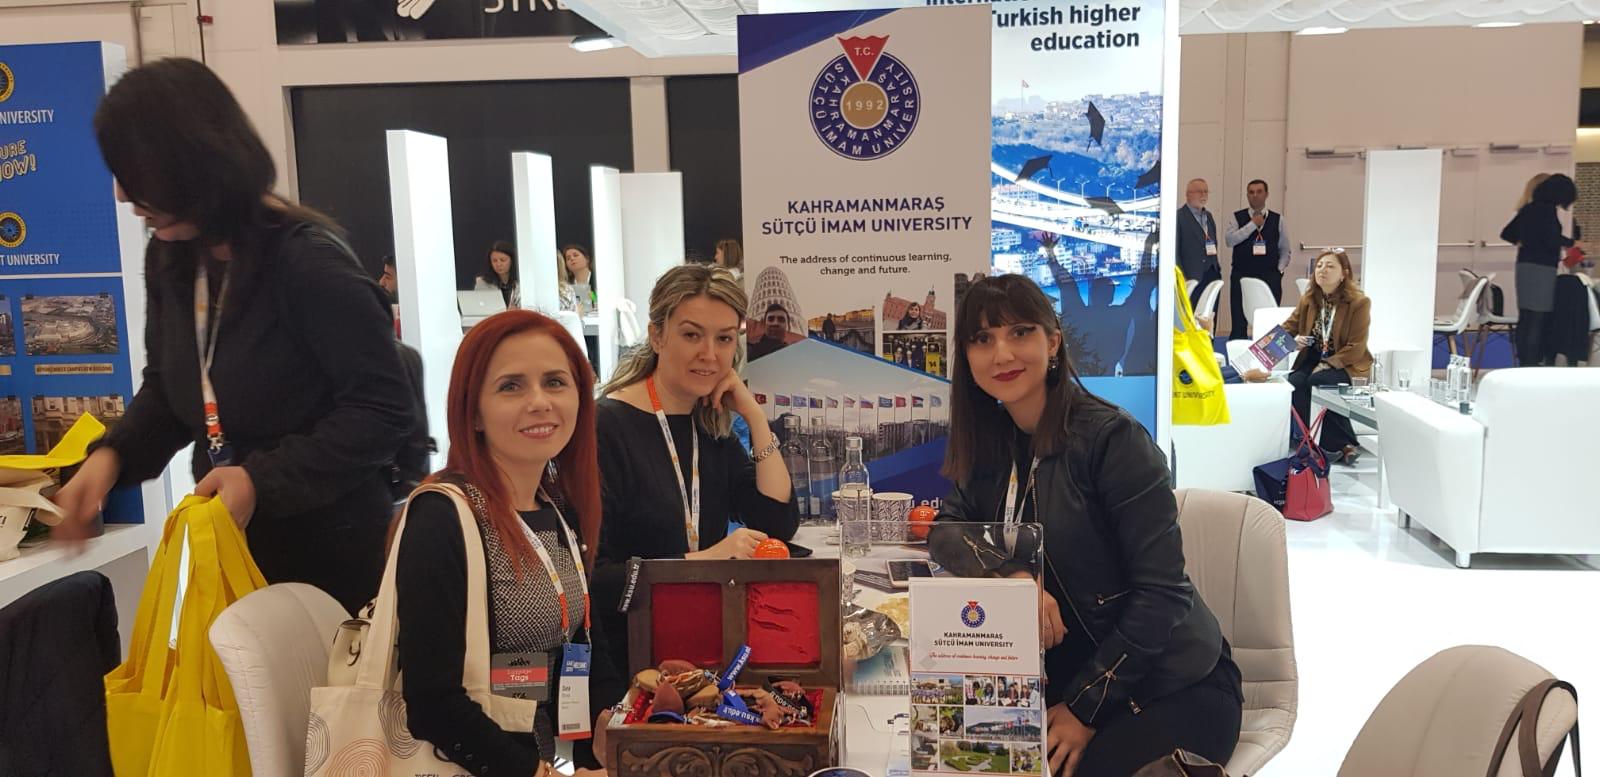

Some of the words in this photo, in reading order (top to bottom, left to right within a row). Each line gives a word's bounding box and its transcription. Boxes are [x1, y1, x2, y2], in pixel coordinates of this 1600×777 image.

[992, 7, 1063, 27] urkish
[1069, 4, 1141, 26] higher
[1030, 30, 1140, 51] education
[854, 47, 875, 56] T.C.
[846, 100, 884, 111] 1992
[871, 63, 914, 154] UNIVERSITY
[0, 153, 37, 182] OW!
[787, 197, 945, 214] KAHRAMANMARAŞ
[761, 217, 817, 236] SÜTÇÜ
[821, 217, 866, 234] İMAM
[871, 216, 973, 232] UNIVERSITY
[7, 253, 60, 266] UNIVERSITY
[779, 256, 798, 264] The
[800, 255, 837, 264] address
[839, 254, 849, 263] of
[851, 253, 906, 263] continuous
[908, 252, 952, 263] learning,
[820, 266, 856, 277] change
[857, 265, 876, 274] and
[878, 264, 911, 274] future.
[943, 631, 1004, 640] KAHRAMANMARAŞ
[510, 674, 529, 683] Tags
